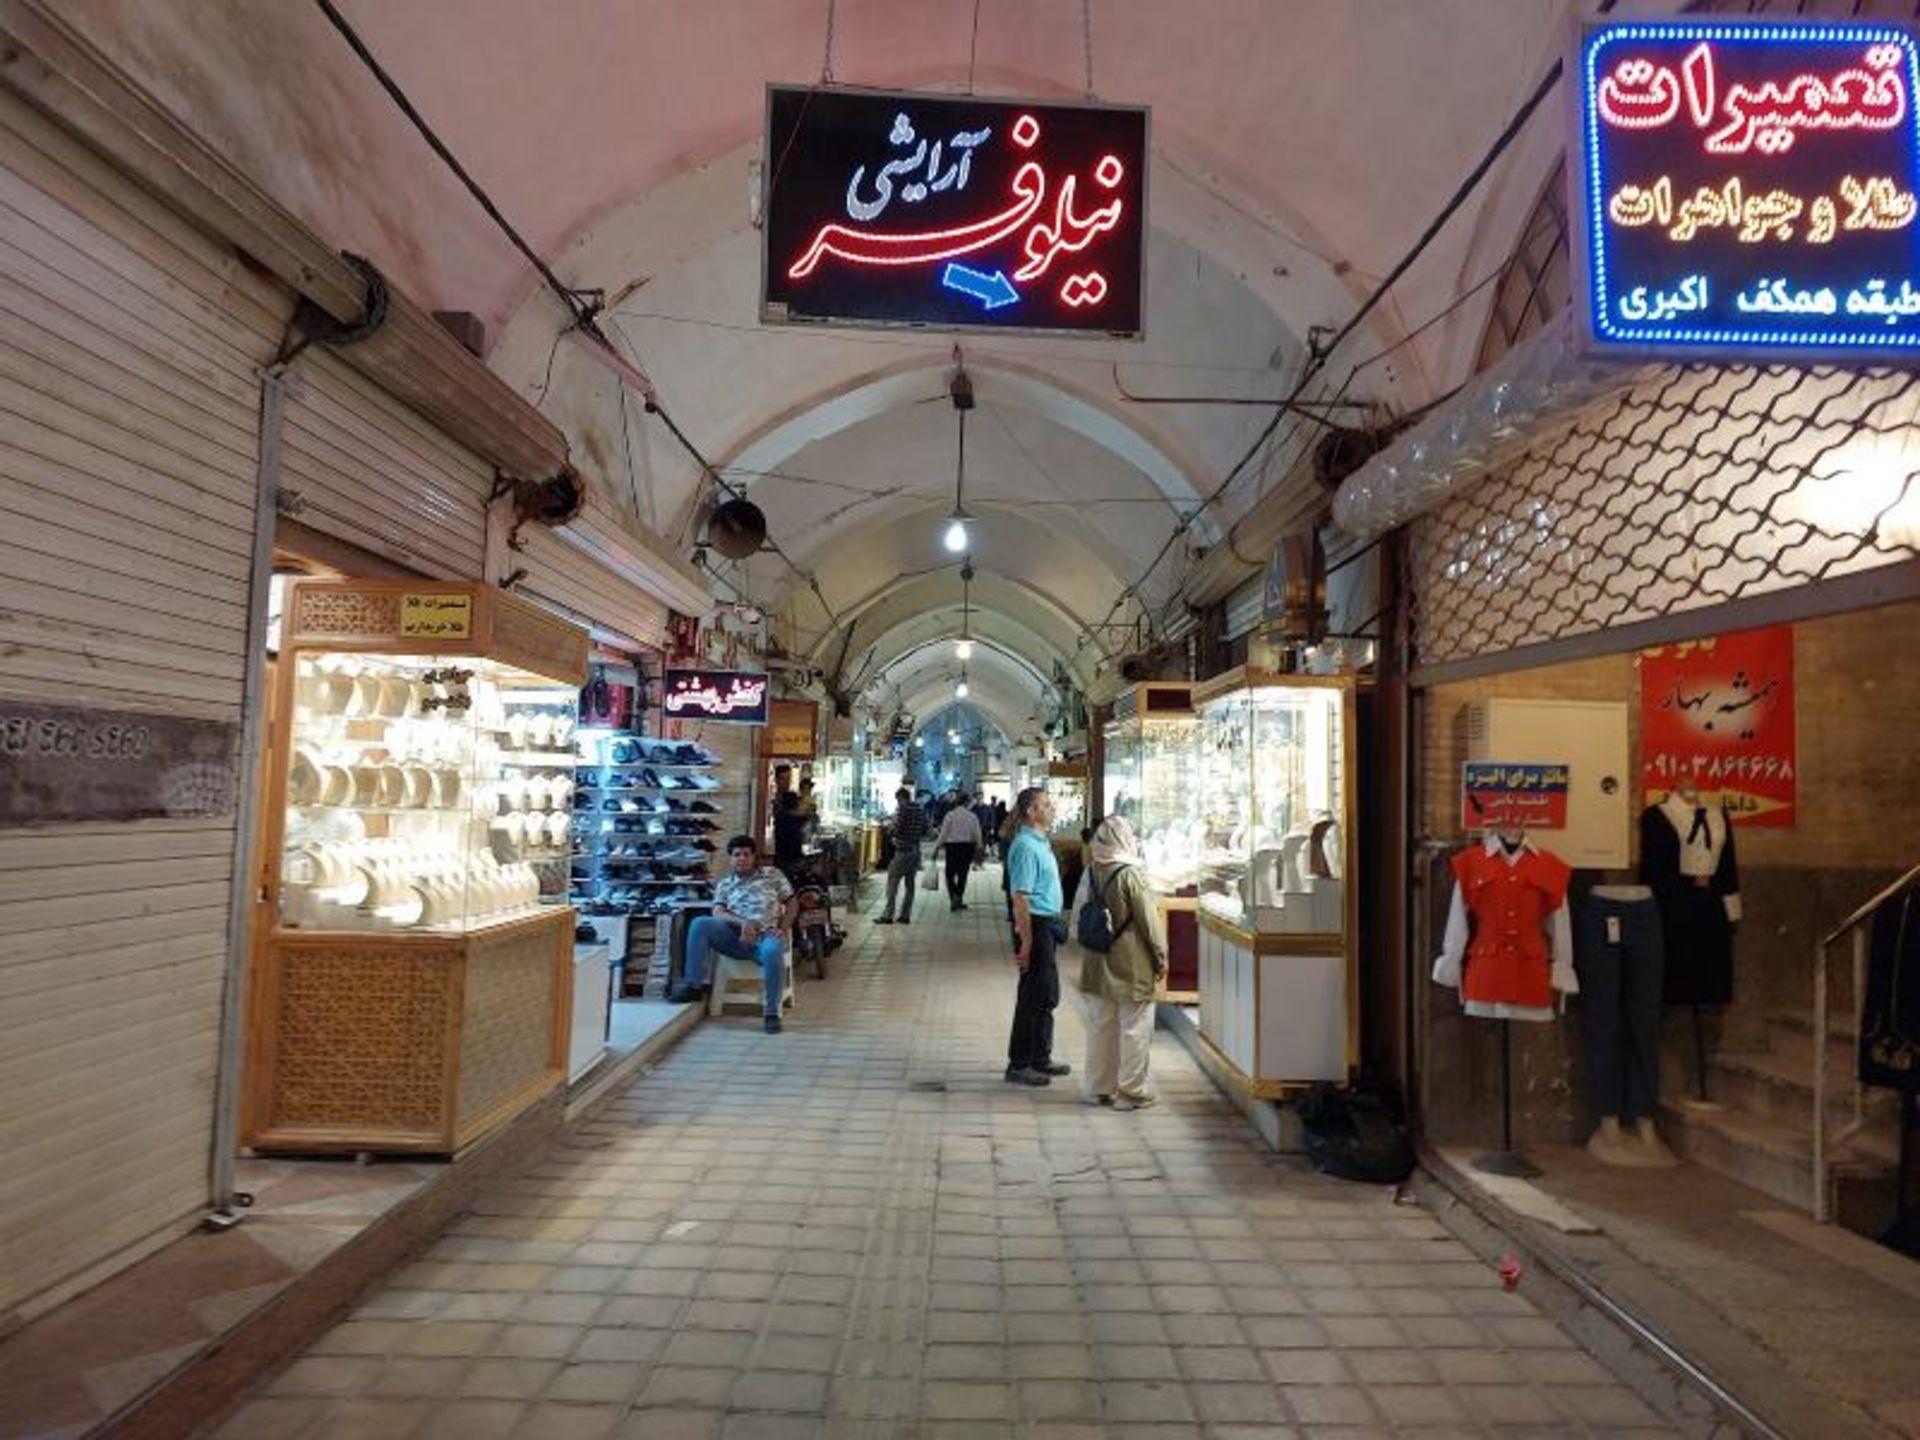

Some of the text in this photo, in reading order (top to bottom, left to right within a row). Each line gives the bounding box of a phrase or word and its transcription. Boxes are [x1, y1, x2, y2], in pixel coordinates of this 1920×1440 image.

[1599, 42, 1905, 152] تعمیرات
[789, 114, 1123, 307] نیلوفر
[846, 112, 992, 221] آرایشی
[1610, 174, 1918, 243] طلا و جواهرات
[1619, 274, 1708, 321] اکبری
[1736, 277, 1838, 314] همکف
